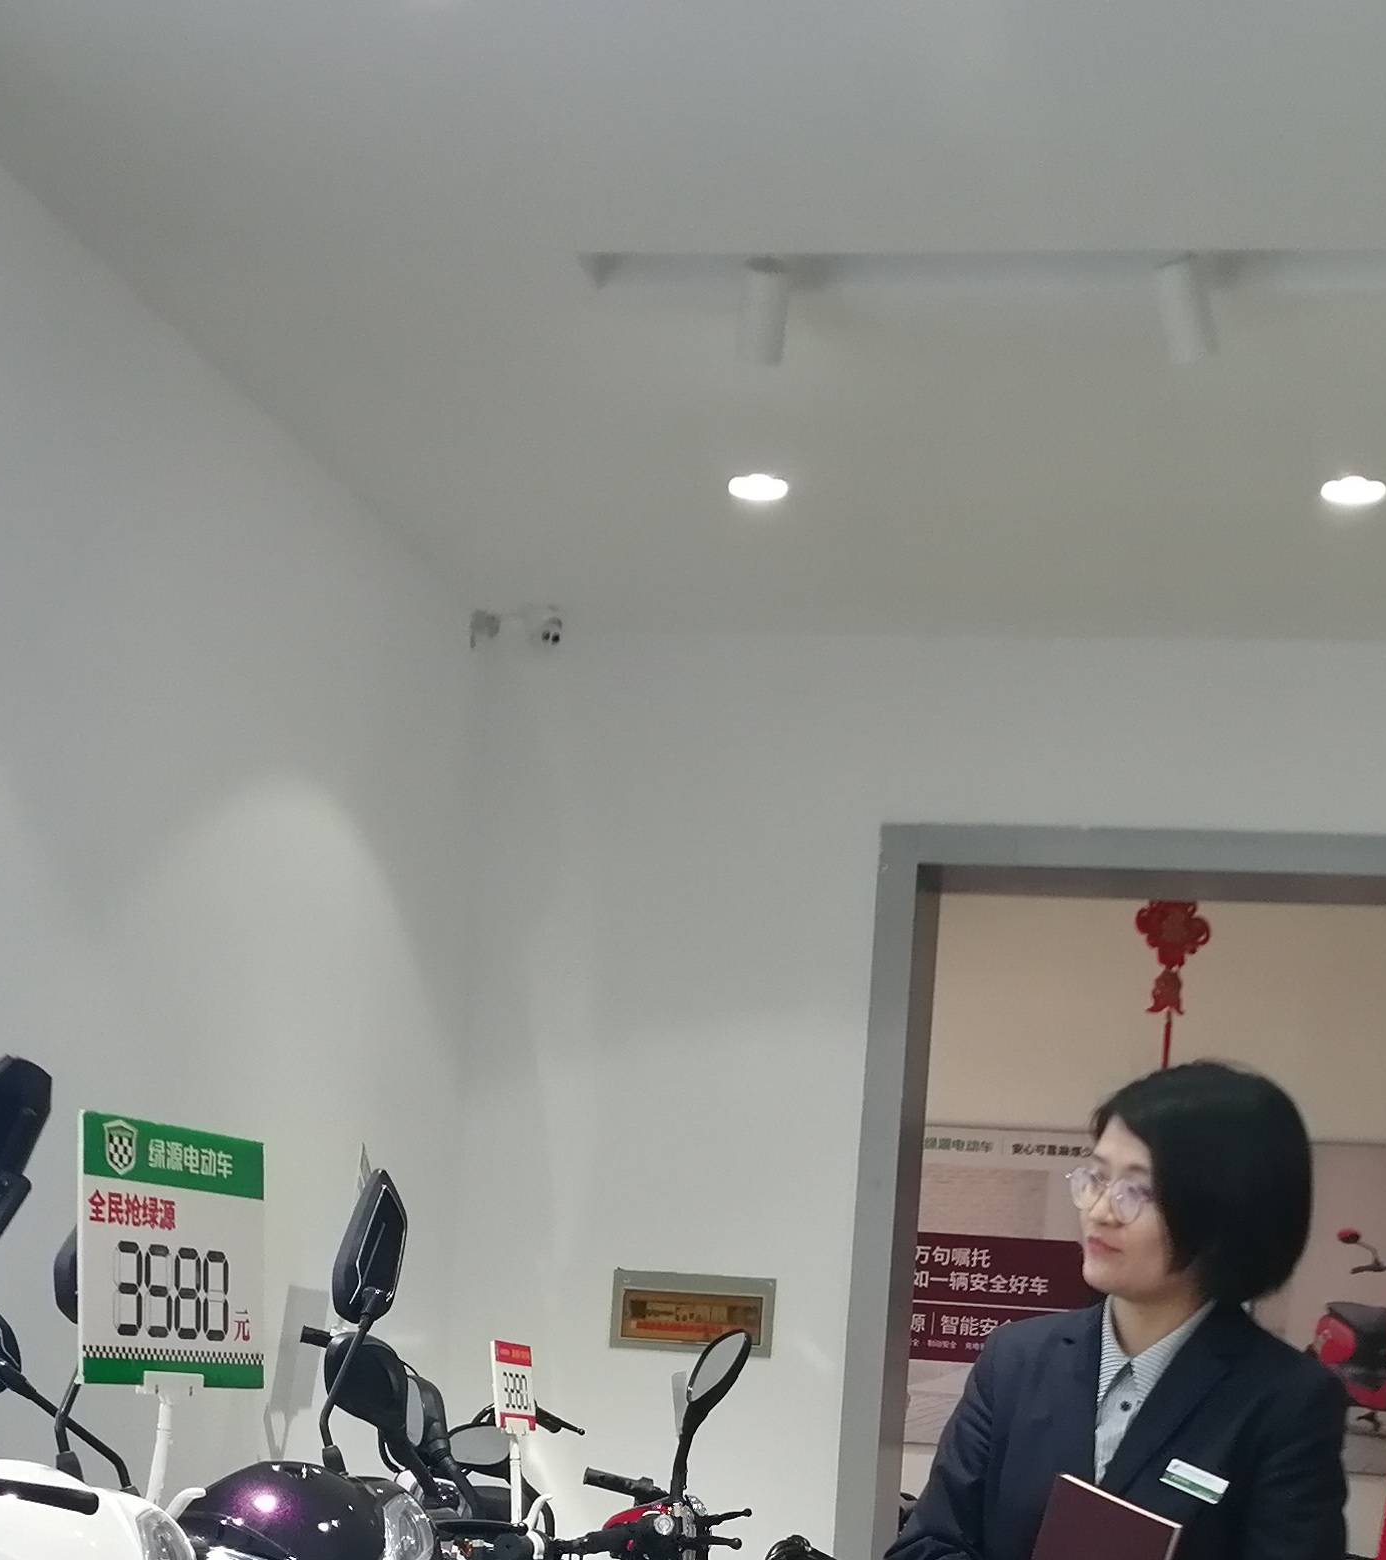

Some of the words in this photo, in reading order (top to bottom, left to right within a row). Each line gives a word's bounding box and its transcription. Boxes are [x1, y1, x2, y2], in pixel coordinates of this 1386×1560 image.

[148, 1138, 234, 1179] 绿源电动车
[88, 1189, 177, 1231] 全民抢绿源
[915, 1245, 991, 1269] 万句嘱托
[116, 1240, 230, 1342] 3580
[940, 1314, 1012, 1337] 智能安
